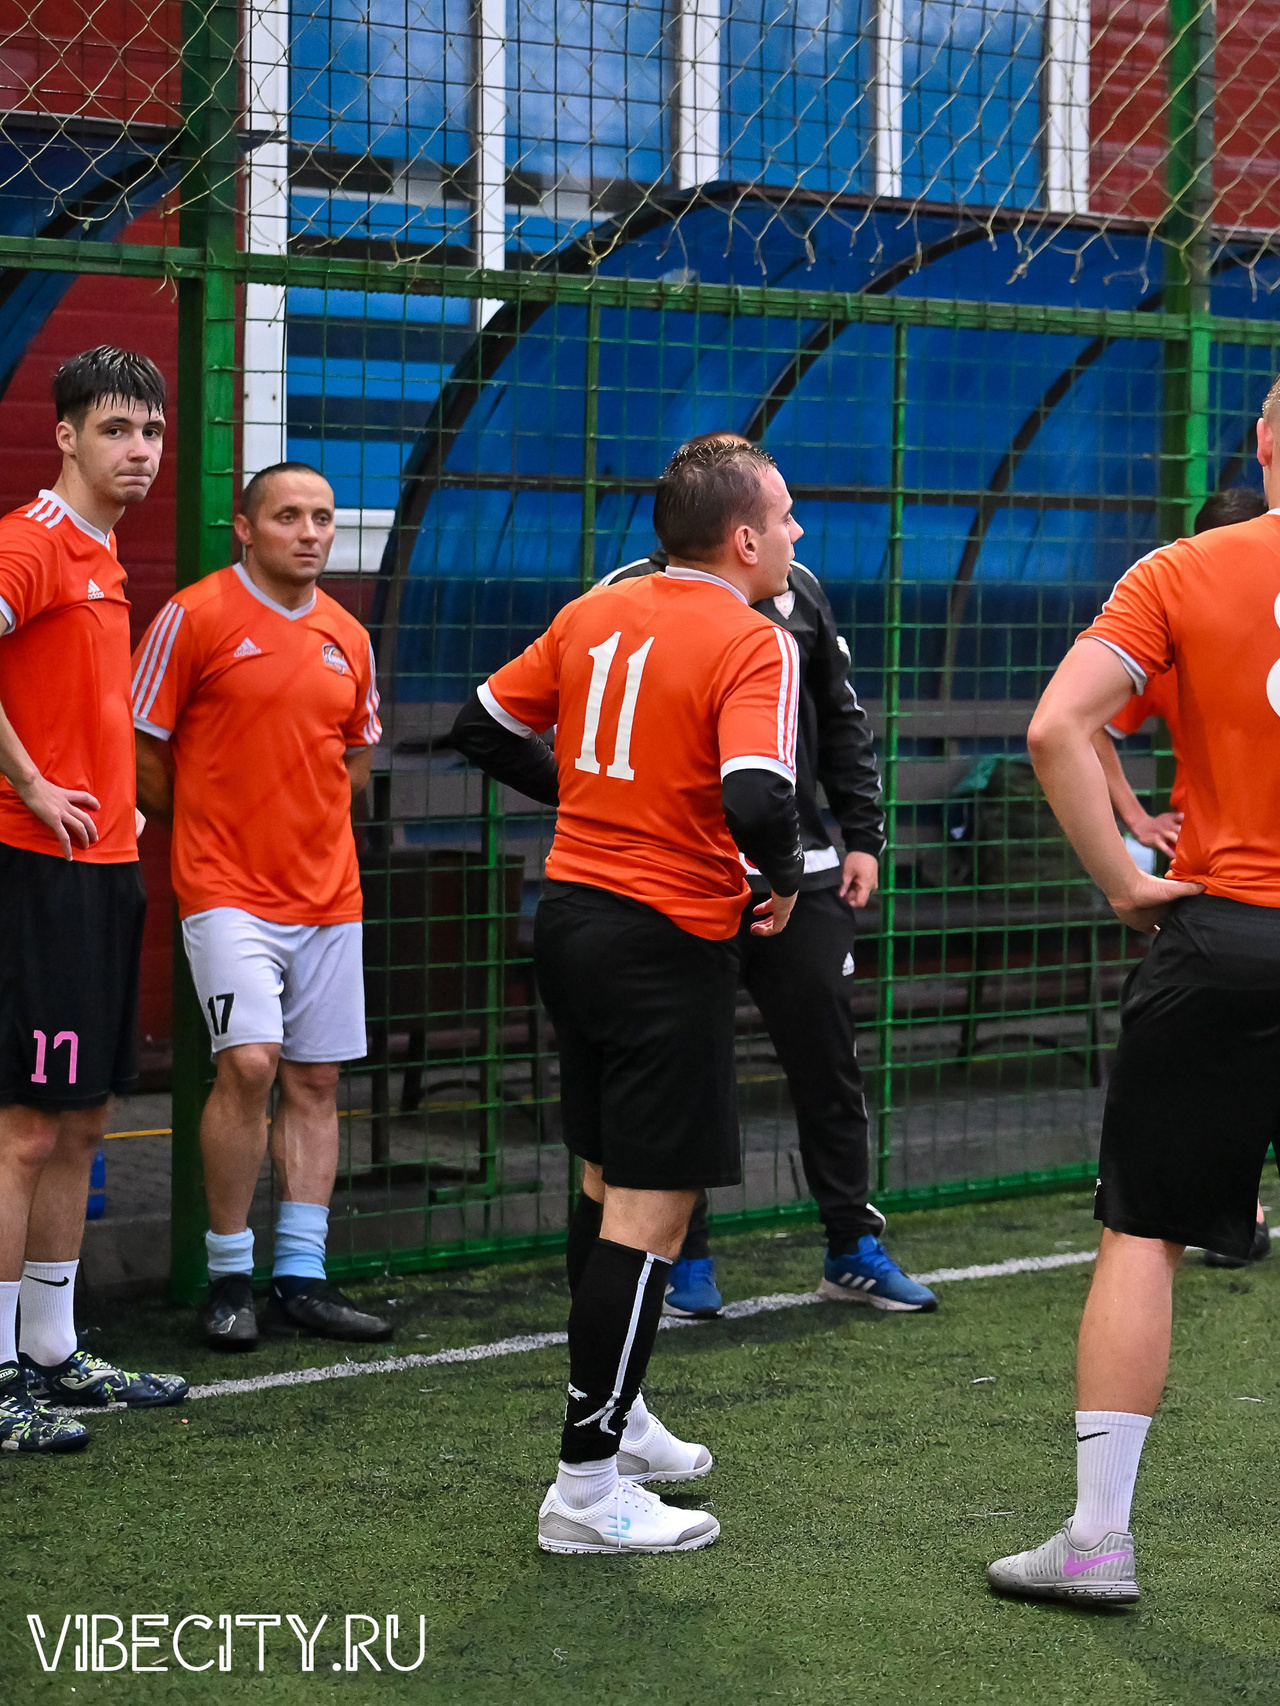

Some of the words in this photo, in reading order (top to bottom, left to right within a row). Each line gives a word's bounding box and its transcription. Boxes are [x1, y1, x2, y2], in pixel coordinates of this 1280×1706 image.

[575, 631, 655, 780] 11
[208, 992, 235, 1036] 17
[31, 1029, 79, 1084] 17
